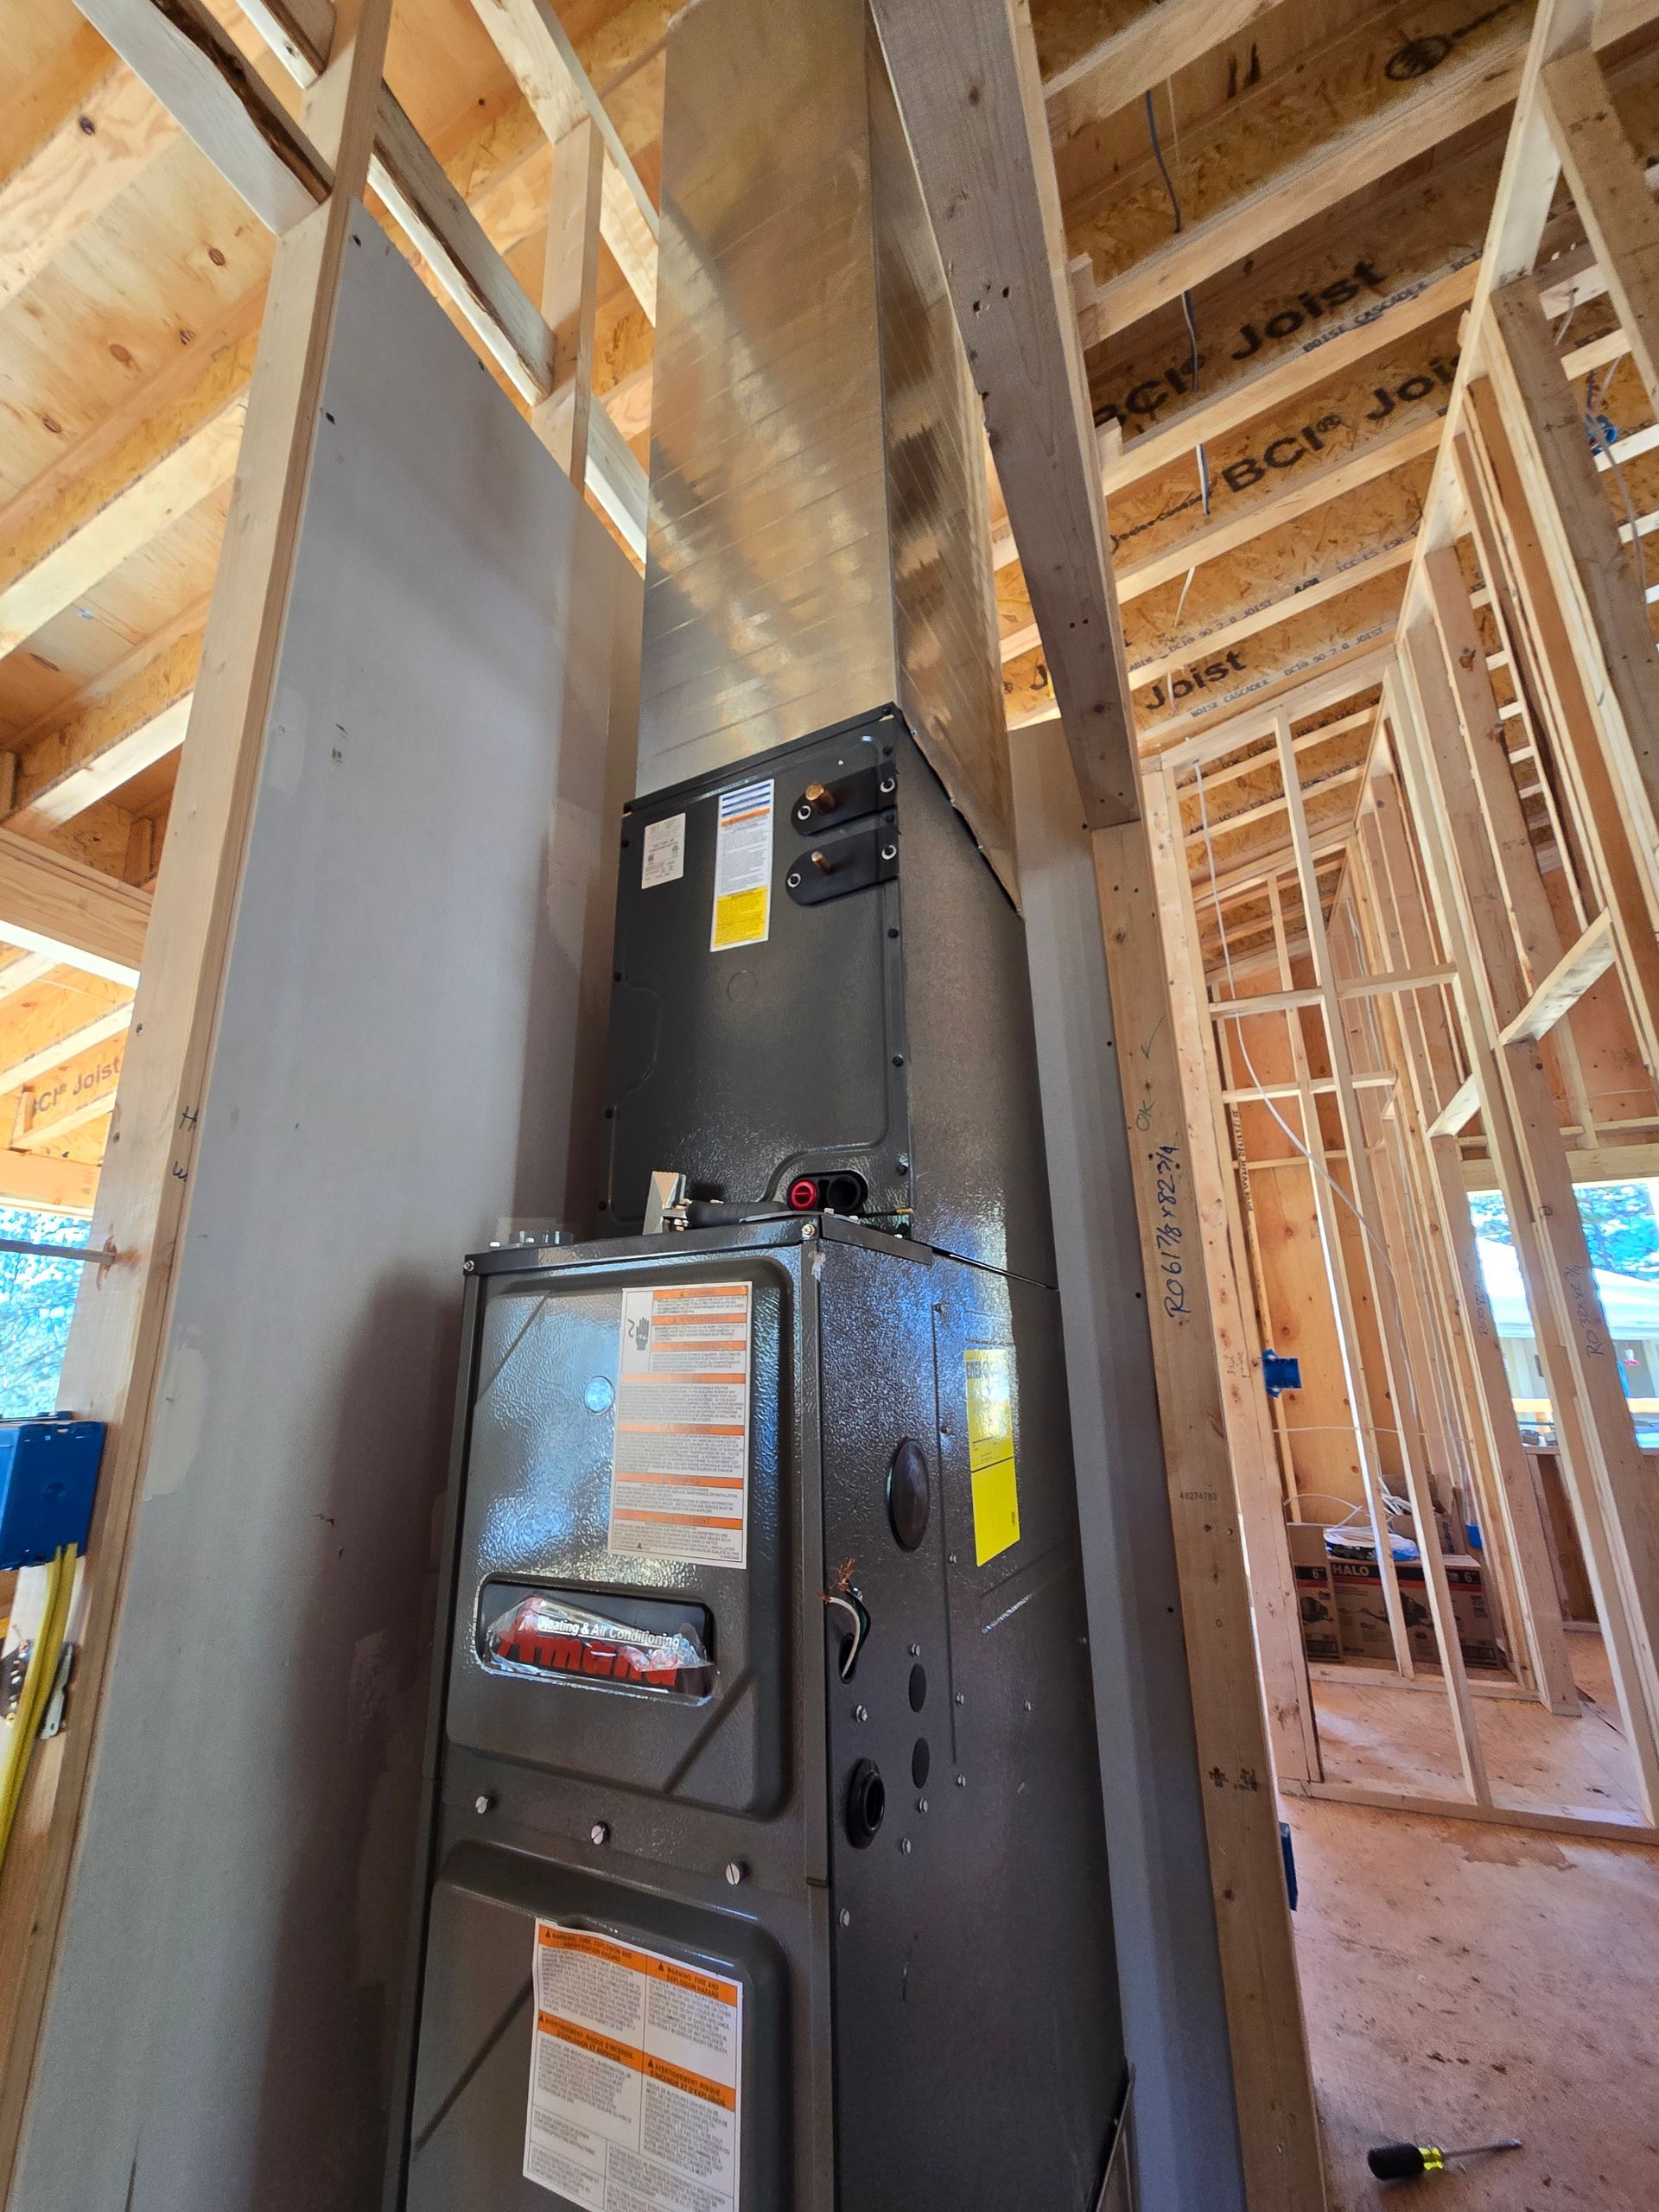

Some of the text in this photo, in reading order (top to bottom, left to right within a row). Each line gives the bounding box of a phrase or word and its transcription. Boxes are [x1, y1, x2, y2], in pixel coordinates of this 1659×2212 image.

[1232, 259, 1386, 360] Joist
[1221, 353, 1460, 493] BCI® Joi
[1243, 600, 1274, 620] JOIST
[1355, 626, 1385, 645] JOIST
[1146, 650, 1248, 710] Joist
[73, 1055, 120, 1096] Joist
[1135, 1100, 1155, 1131] OK
[1332, 1563, 1370, 1577] HALO
[581, 1622, 590, 1635] &
[591, 1624, 607, 1637] Air
[609, 1626, 681, 1650] Conditioning
